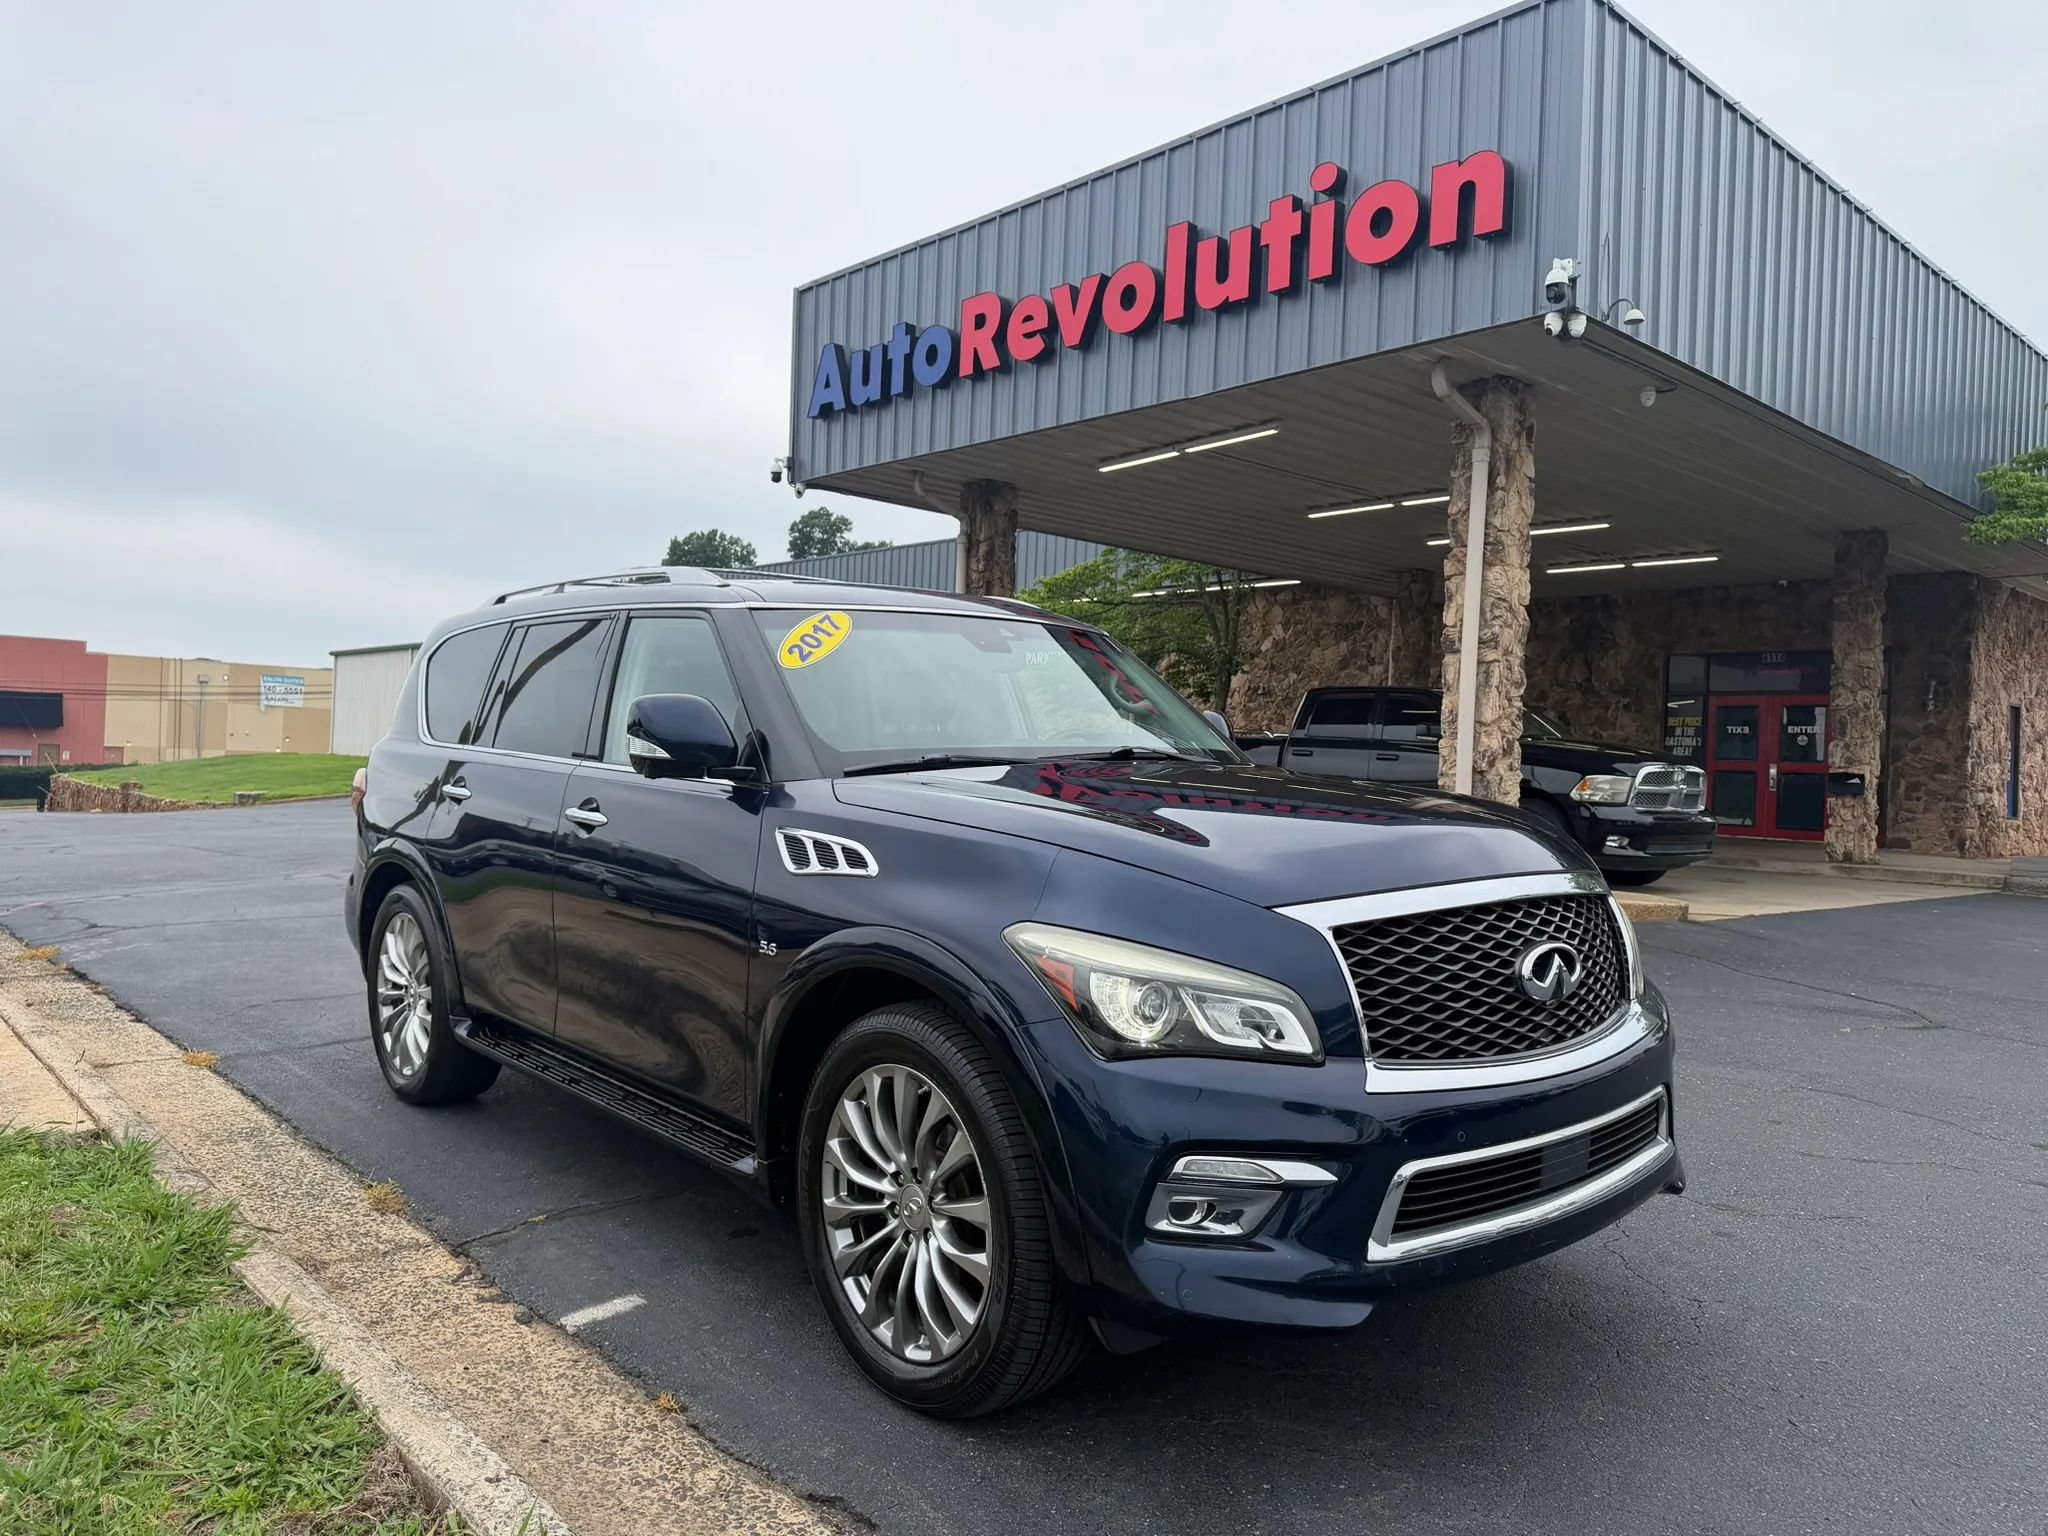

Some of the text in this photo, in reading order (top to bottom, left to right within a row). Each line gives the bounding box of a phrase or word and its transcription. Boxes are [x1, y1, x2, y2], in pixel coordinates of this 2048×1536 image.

[787, 614, 840, 662] 2017
[1667, 716, 1703, 726] BEST PRICE
[1683, 727, 1696, 736] THE
[1787, 725, 1819, 734] ENTER
[759, 940, 777, 956] 5.6
